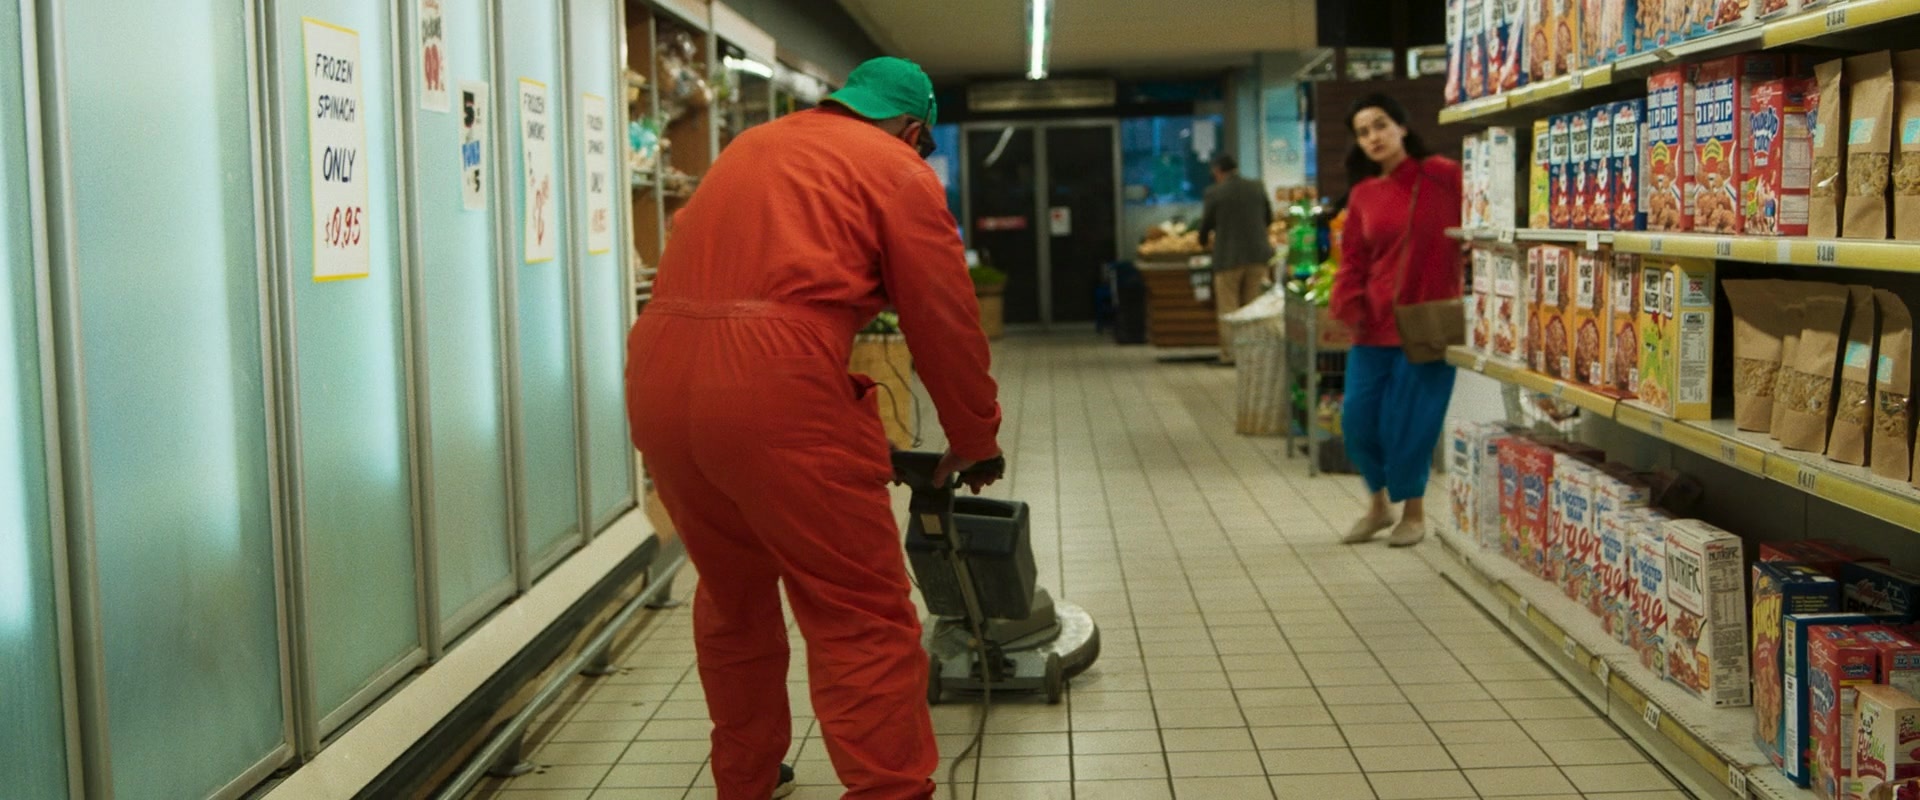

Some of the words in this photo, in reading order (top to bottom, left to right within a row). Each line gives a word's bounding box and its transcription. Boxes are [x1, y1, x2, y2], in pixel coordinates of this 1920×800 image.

[315, 53, 353, 85] FROZEN
[317, 95, 356, 123] SPINACH
[1661, 106, 1677, 126] DIP
[1696, 106, 1714, 124] DIP
[1714, 104, 1733, 123] DIP
[323, 147, 356, 183] ONLY
